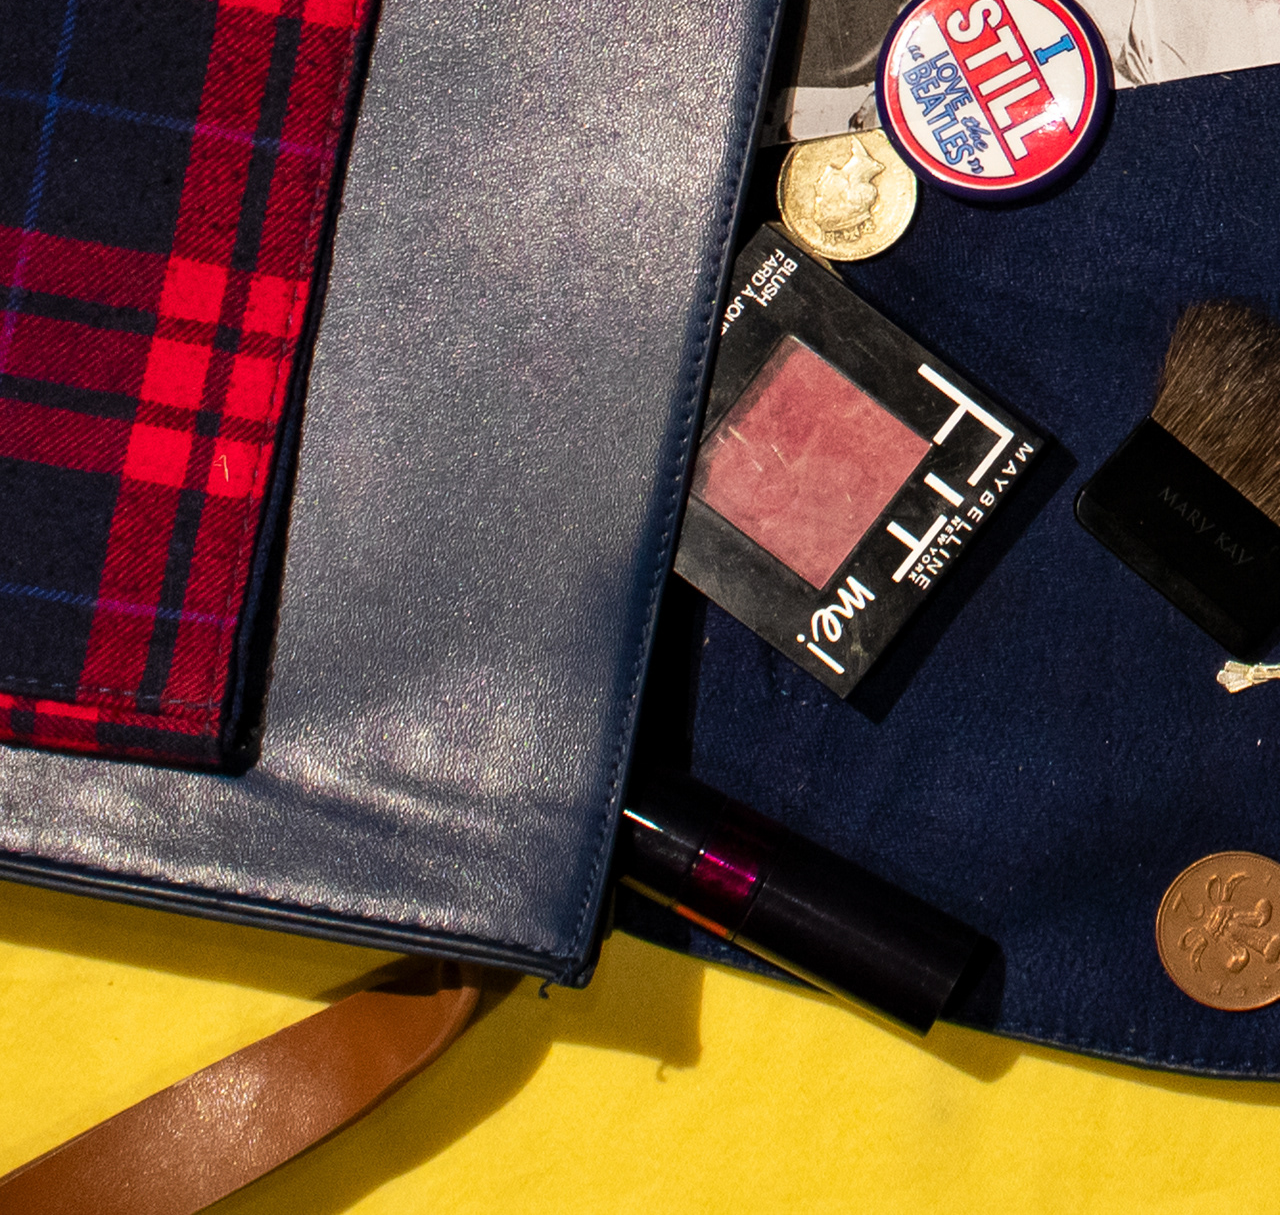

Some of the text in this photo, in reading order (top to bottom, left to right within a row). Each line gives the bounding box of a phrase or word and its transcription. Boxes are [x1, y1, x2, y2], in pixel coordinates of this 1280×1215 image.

[1034, 34, 1076, 66] I
[929, 50, 991, 153] LOVE the
[751, 248, 785, 286] FARD
[756, 258, 798, 307] BLUSH
[887, 363, 1015, 583] FIT
[908, 515, 962, 581] NEW YORK
[914, 441, 1034, 591] MAYBELLINE
[1158, 486, 1255, 566] MARY KAY
[796, 575, 876, 675] me!
